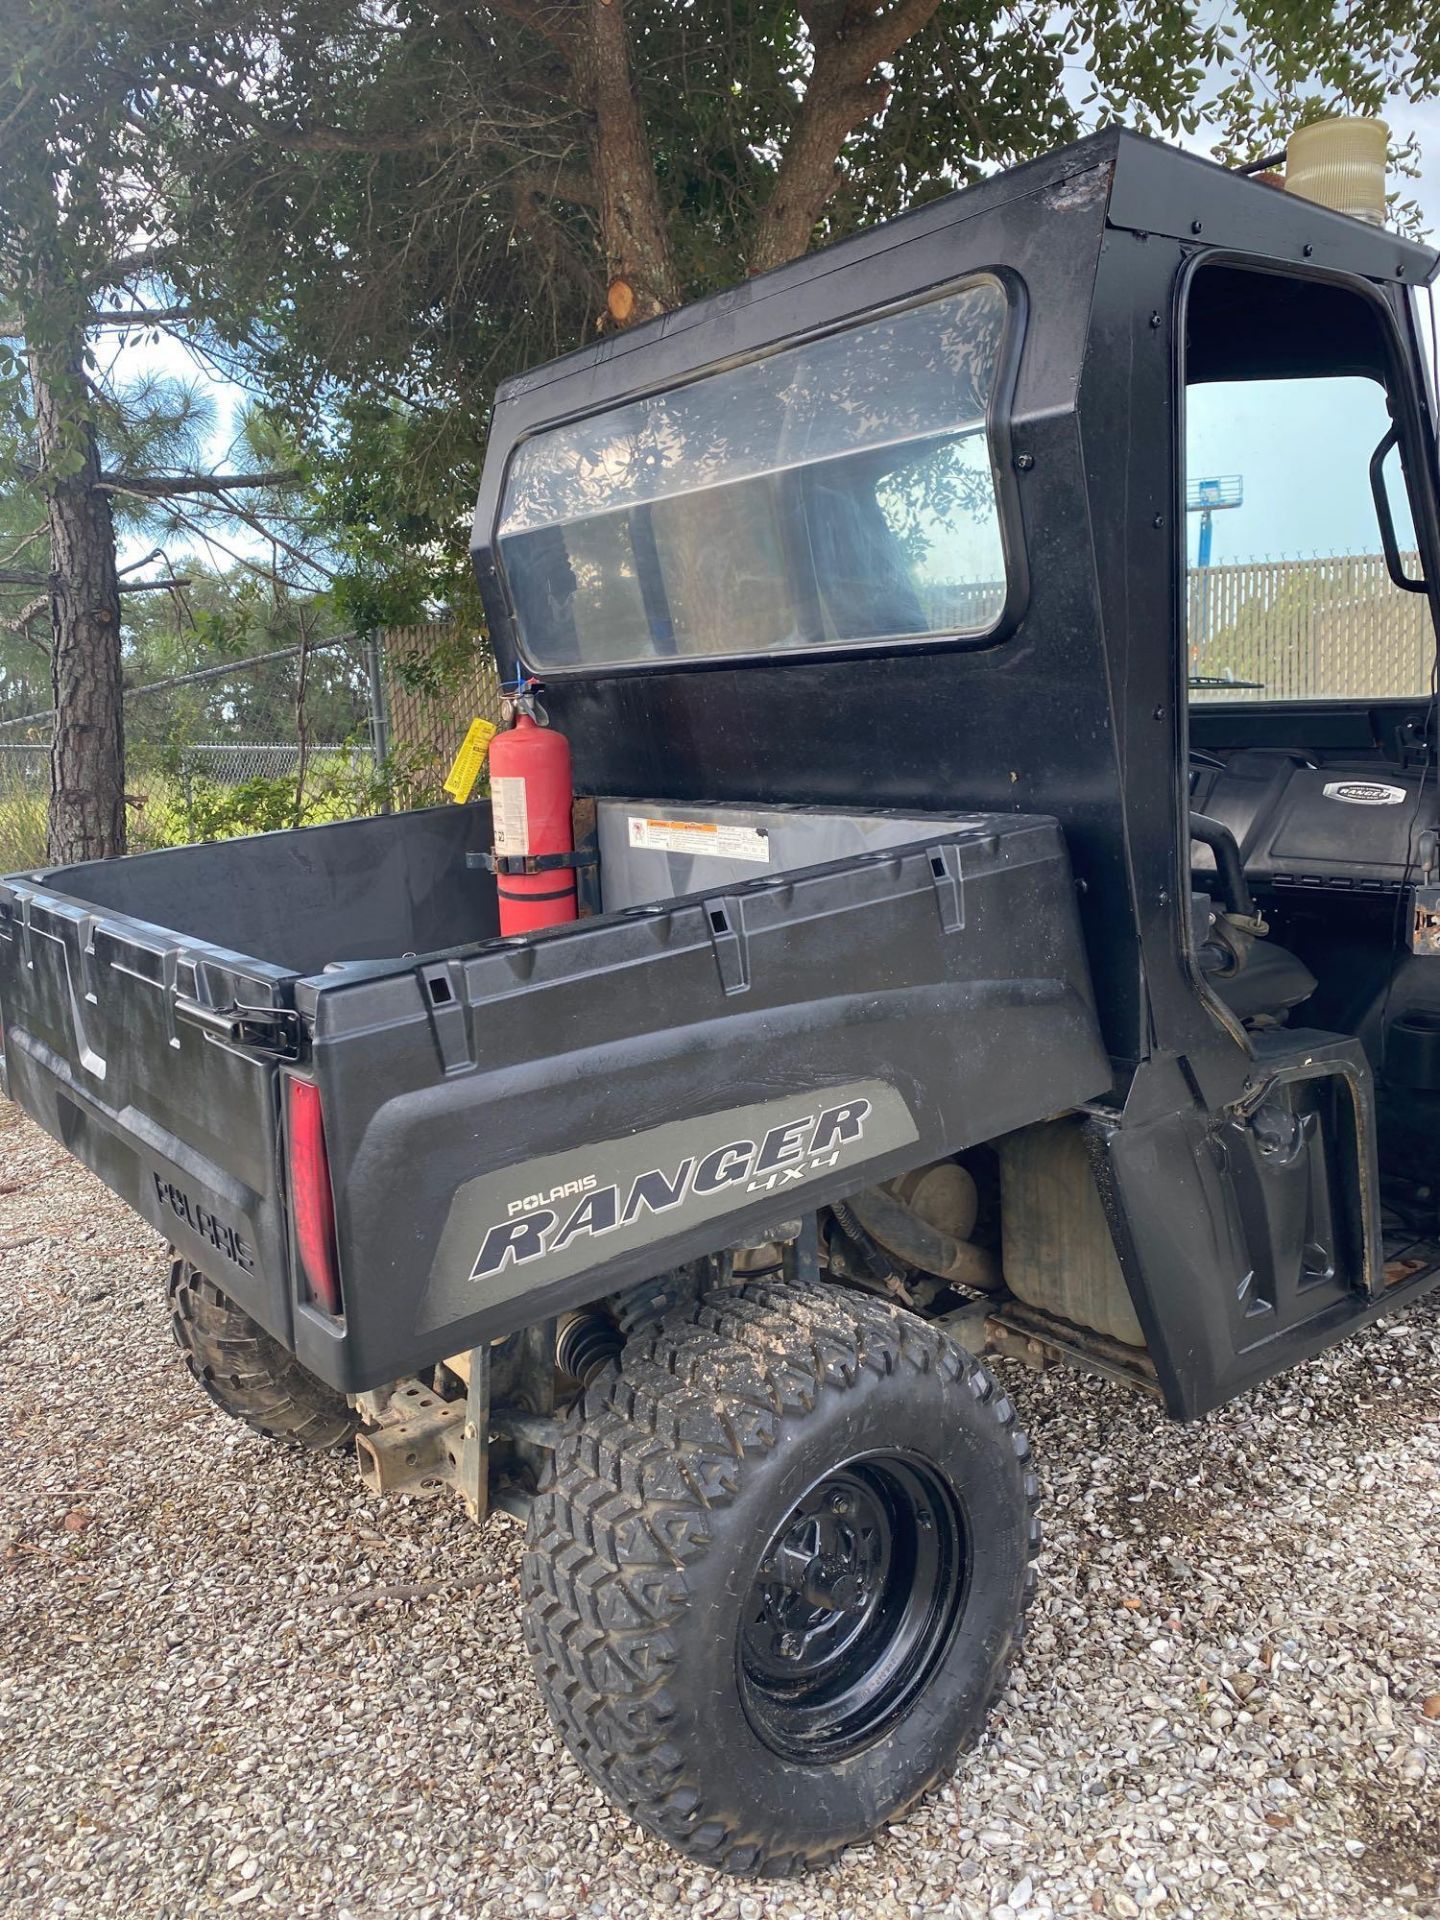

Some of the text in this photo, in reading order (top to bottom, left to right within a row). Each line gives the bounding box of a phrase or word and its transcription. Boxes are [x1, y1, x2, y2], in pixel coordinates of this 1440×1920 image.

[153, 1170, 255, 1278] POLARIS
[468, 1098, 873, 1282] RANGER
[507, 1174, 598, 1217] POLARIS
